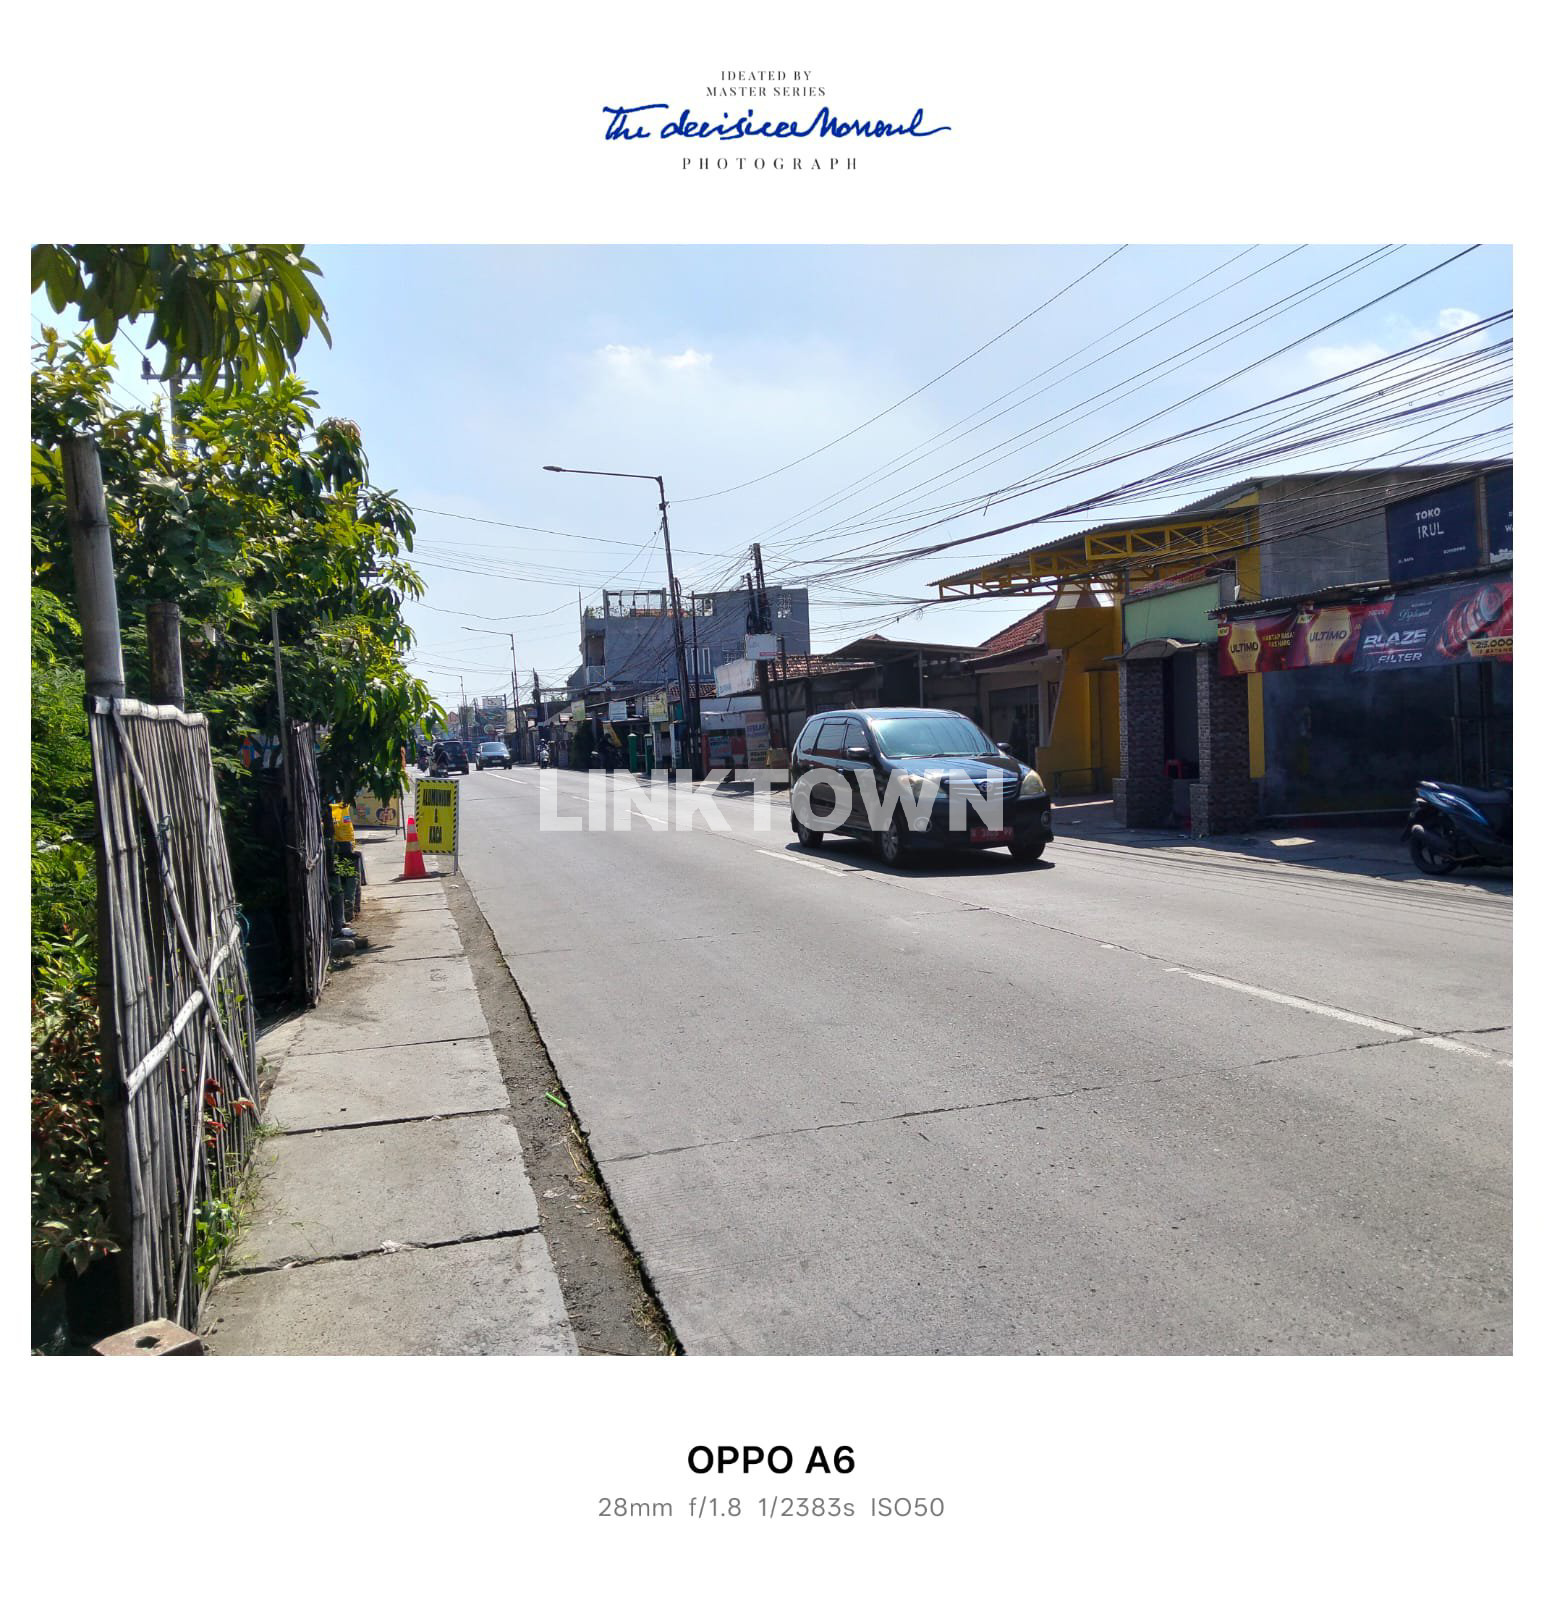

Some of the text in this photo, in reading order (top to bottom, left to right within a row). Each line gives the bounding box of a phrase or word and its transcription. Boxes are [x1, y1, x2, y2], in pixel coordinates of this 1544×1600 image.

[1416, 507, 1441, 520] TOKO
[1418, 522, 1444, 539] IRUL
[1309, 630, 1347, 642] ULTIMO
[1363, 629, 1427, 648] BLAZE
[1230, 642, 1258, 653] ULTIMO
[1378, 652, 1422, 664] FILTER
